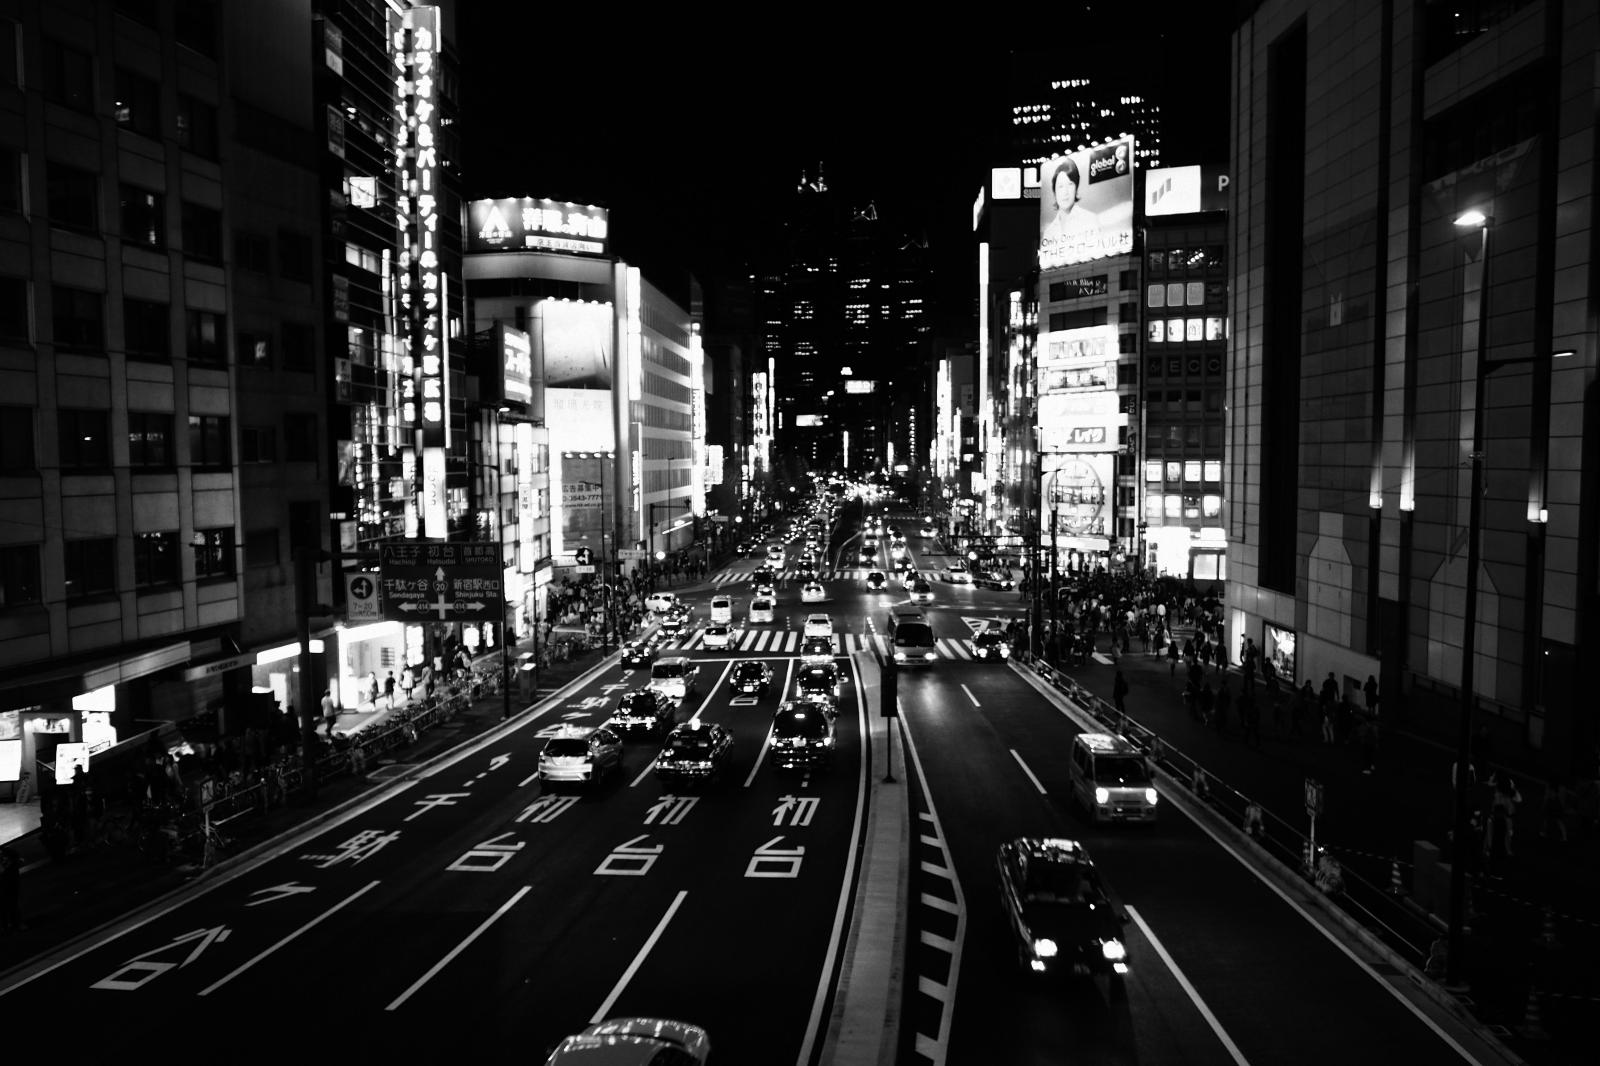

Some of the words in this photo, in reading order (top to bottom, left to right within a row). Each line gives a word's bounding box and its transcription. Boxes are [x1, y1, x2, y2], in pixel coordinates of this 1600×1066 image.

[1090, 155, 1115, 177] global
[1218, 175, 1230, 192] P
[384, 545, 421, 558] 八王子
[428, 545, 455, 558] 初台
[436, 583, 445, 591] 20
[453, 578, 500, 591] 新宿駅西口
[455, 591, 484, 599] Shinjuku
[446, 794, 580, 873] 初台
[594, 794, 700, 877] 初台
[745, 794, 820, 879] 初台
